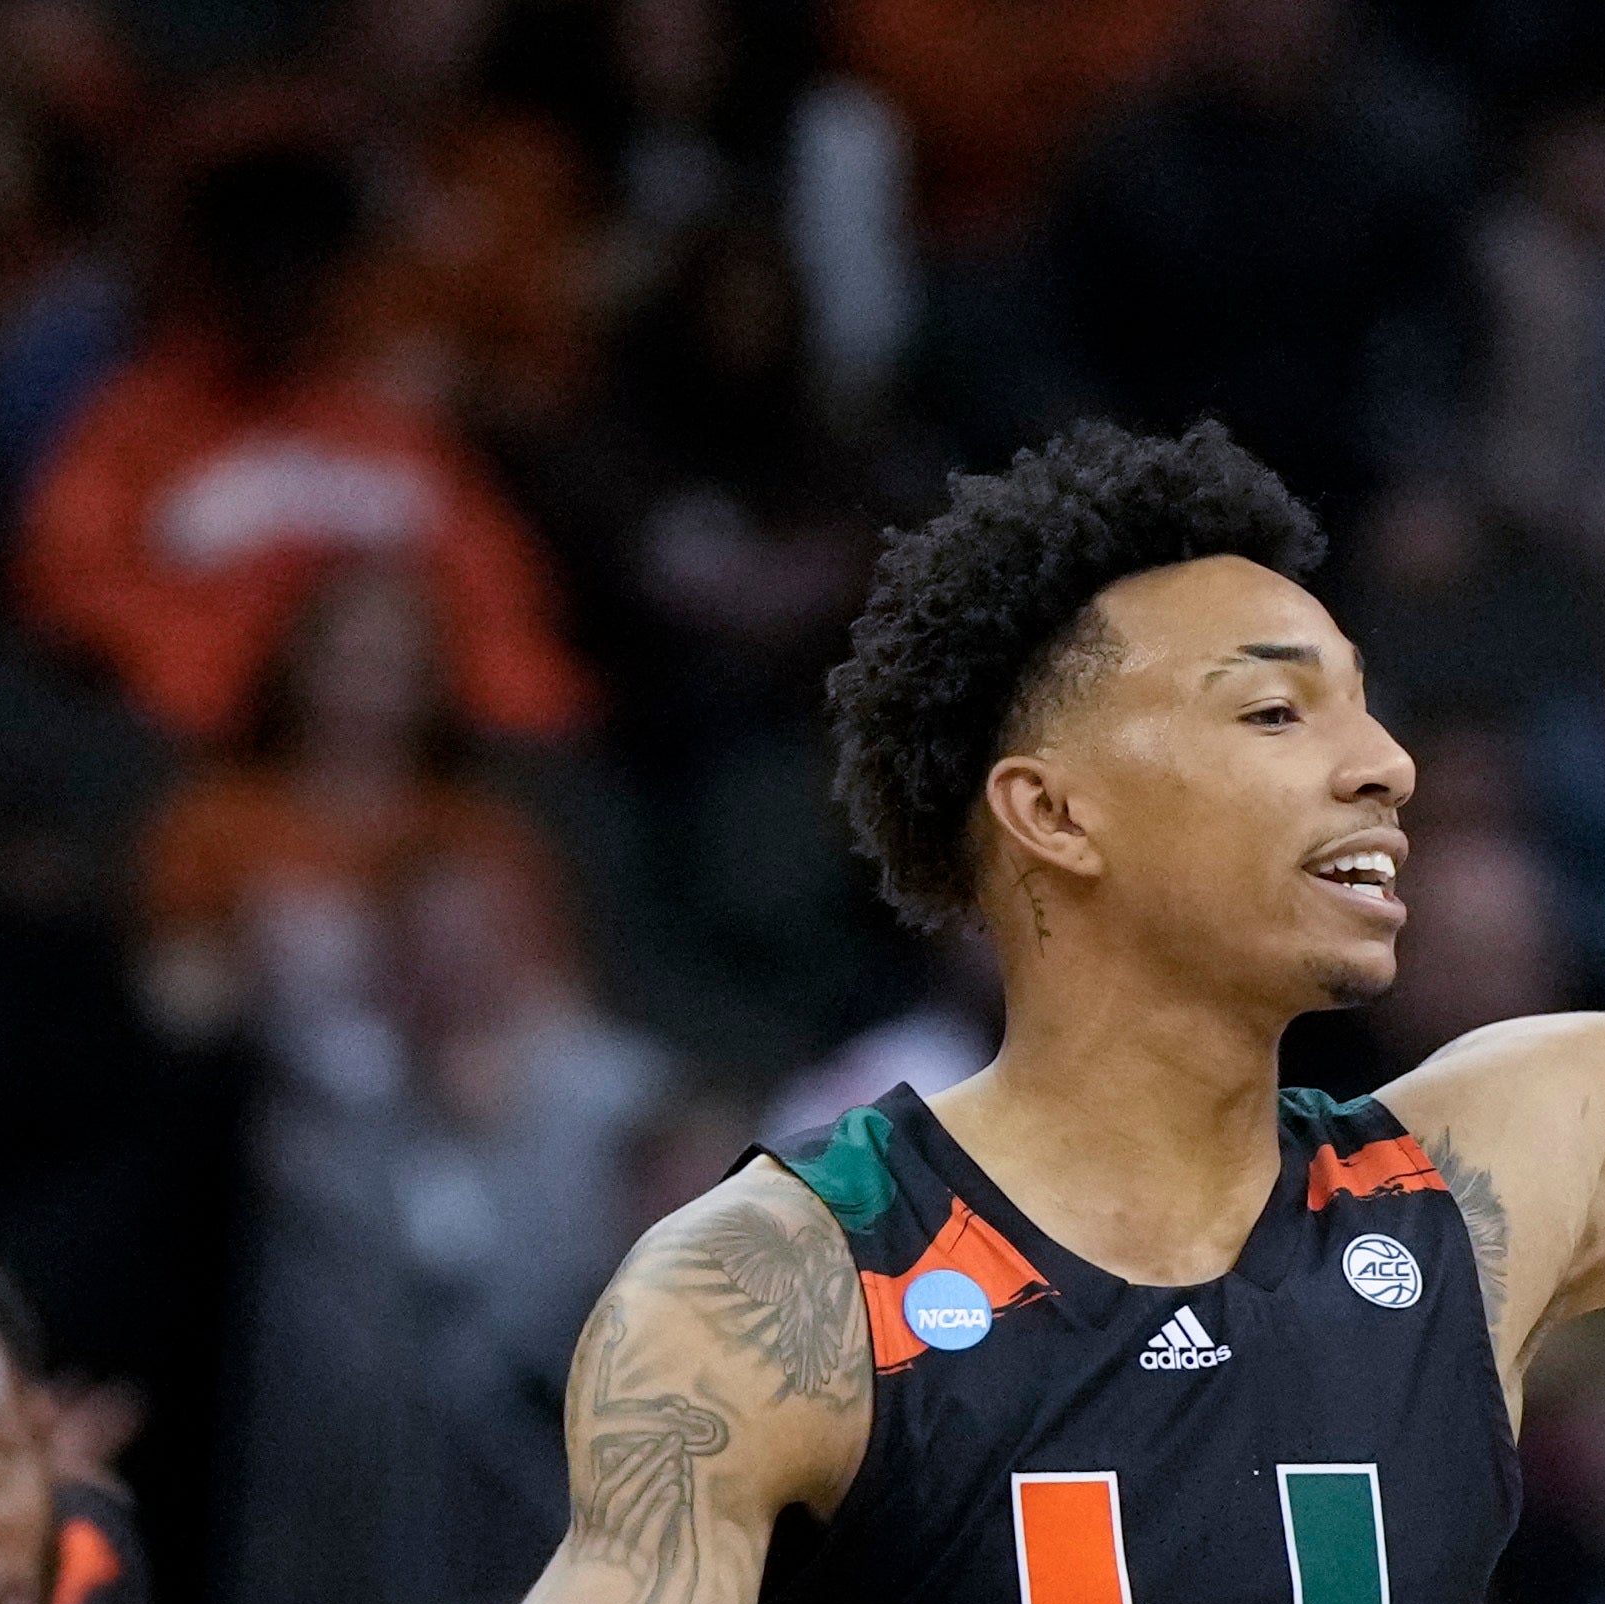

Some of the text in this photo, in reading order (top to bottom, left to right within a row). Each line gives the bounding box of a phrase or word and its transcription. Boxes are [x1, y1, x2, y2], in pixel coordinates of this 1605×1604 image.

[1357, 1260, 1411, 1277] ACC
[917, 1308, 988, 1329] NCAA
[1139, 1344, 1233, 1370] adidas
